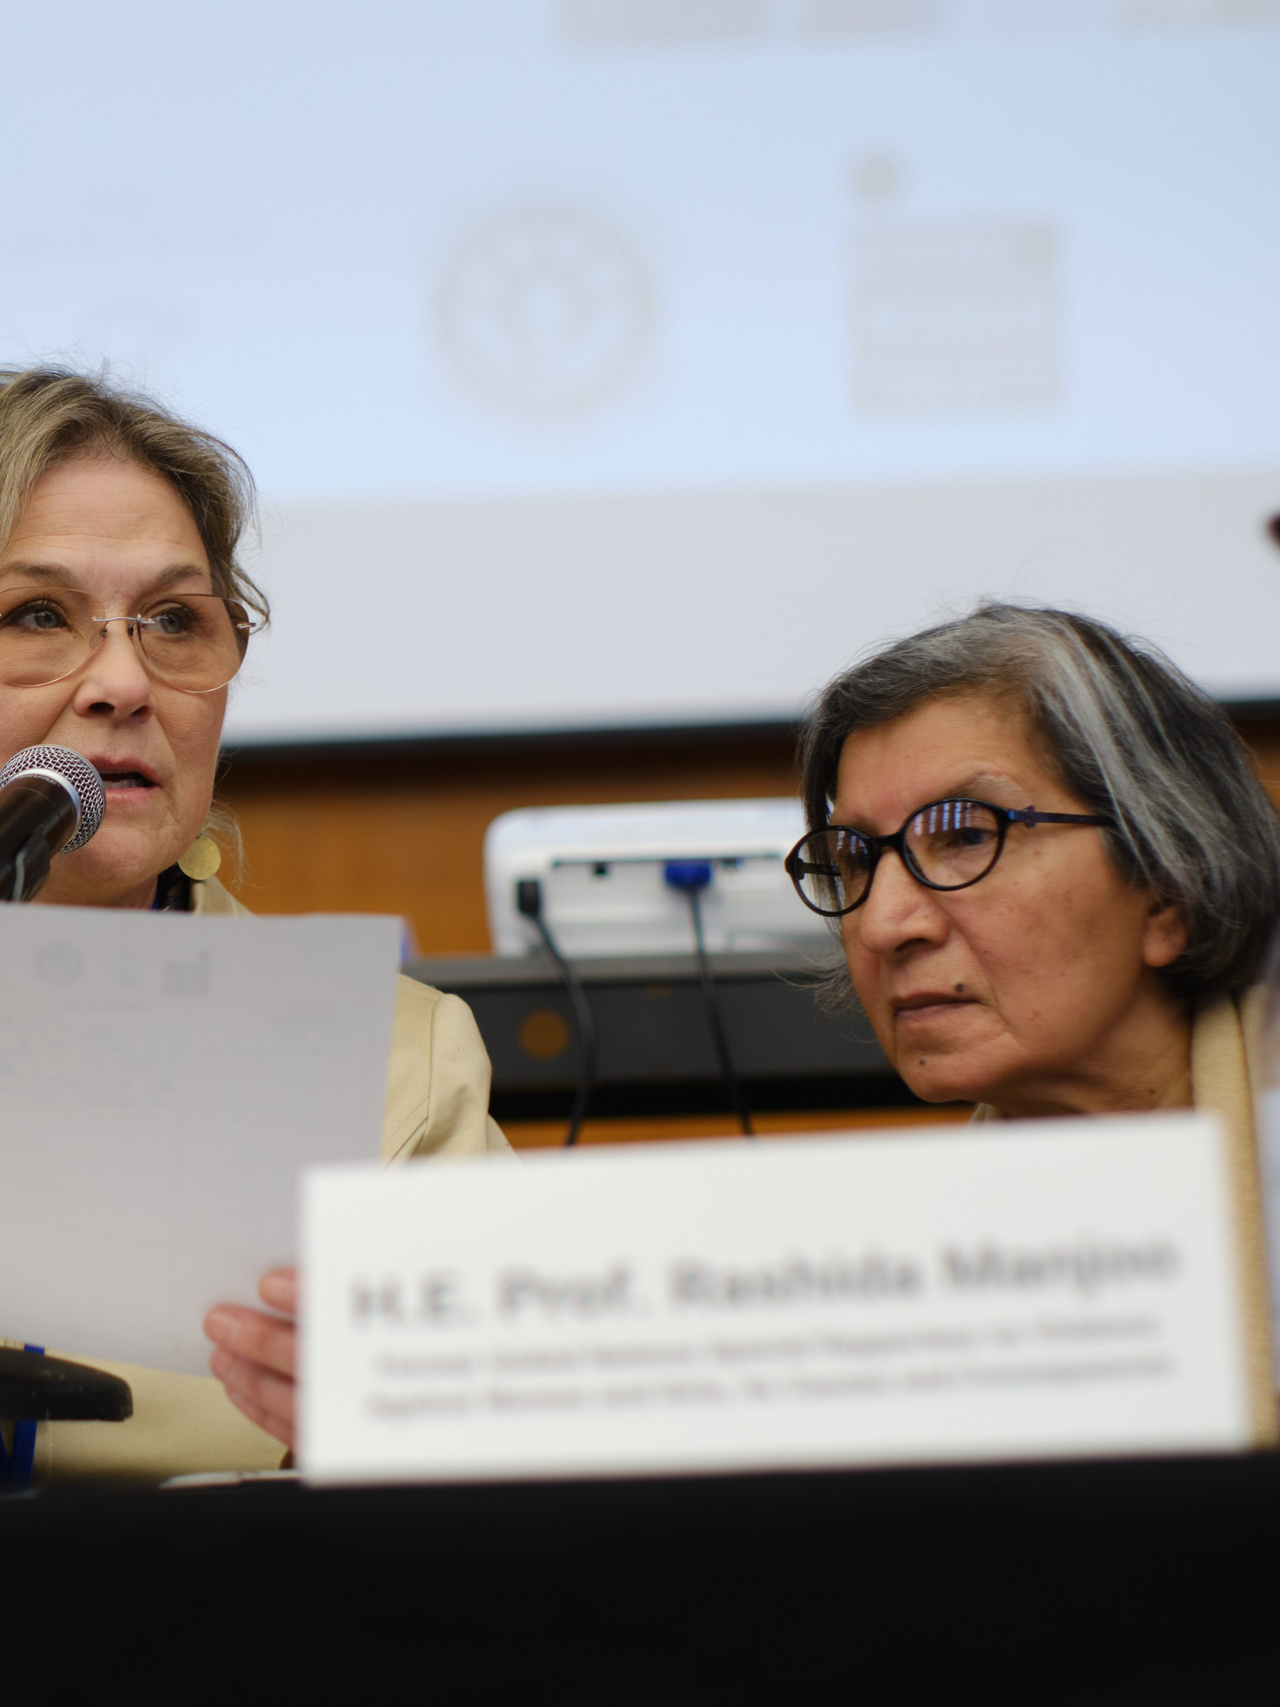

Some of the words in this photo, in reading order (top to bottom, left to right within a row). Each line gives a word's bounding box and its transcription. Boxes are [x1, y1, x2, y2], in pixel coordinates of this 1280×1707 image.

[350, 1273, 484, 1329] H.E.
[495, 1261, 651, 1321] Prof.
[662, 1245, 928, 1311] Rashida
[938, 1229, 1182, 1307] Manjoo
